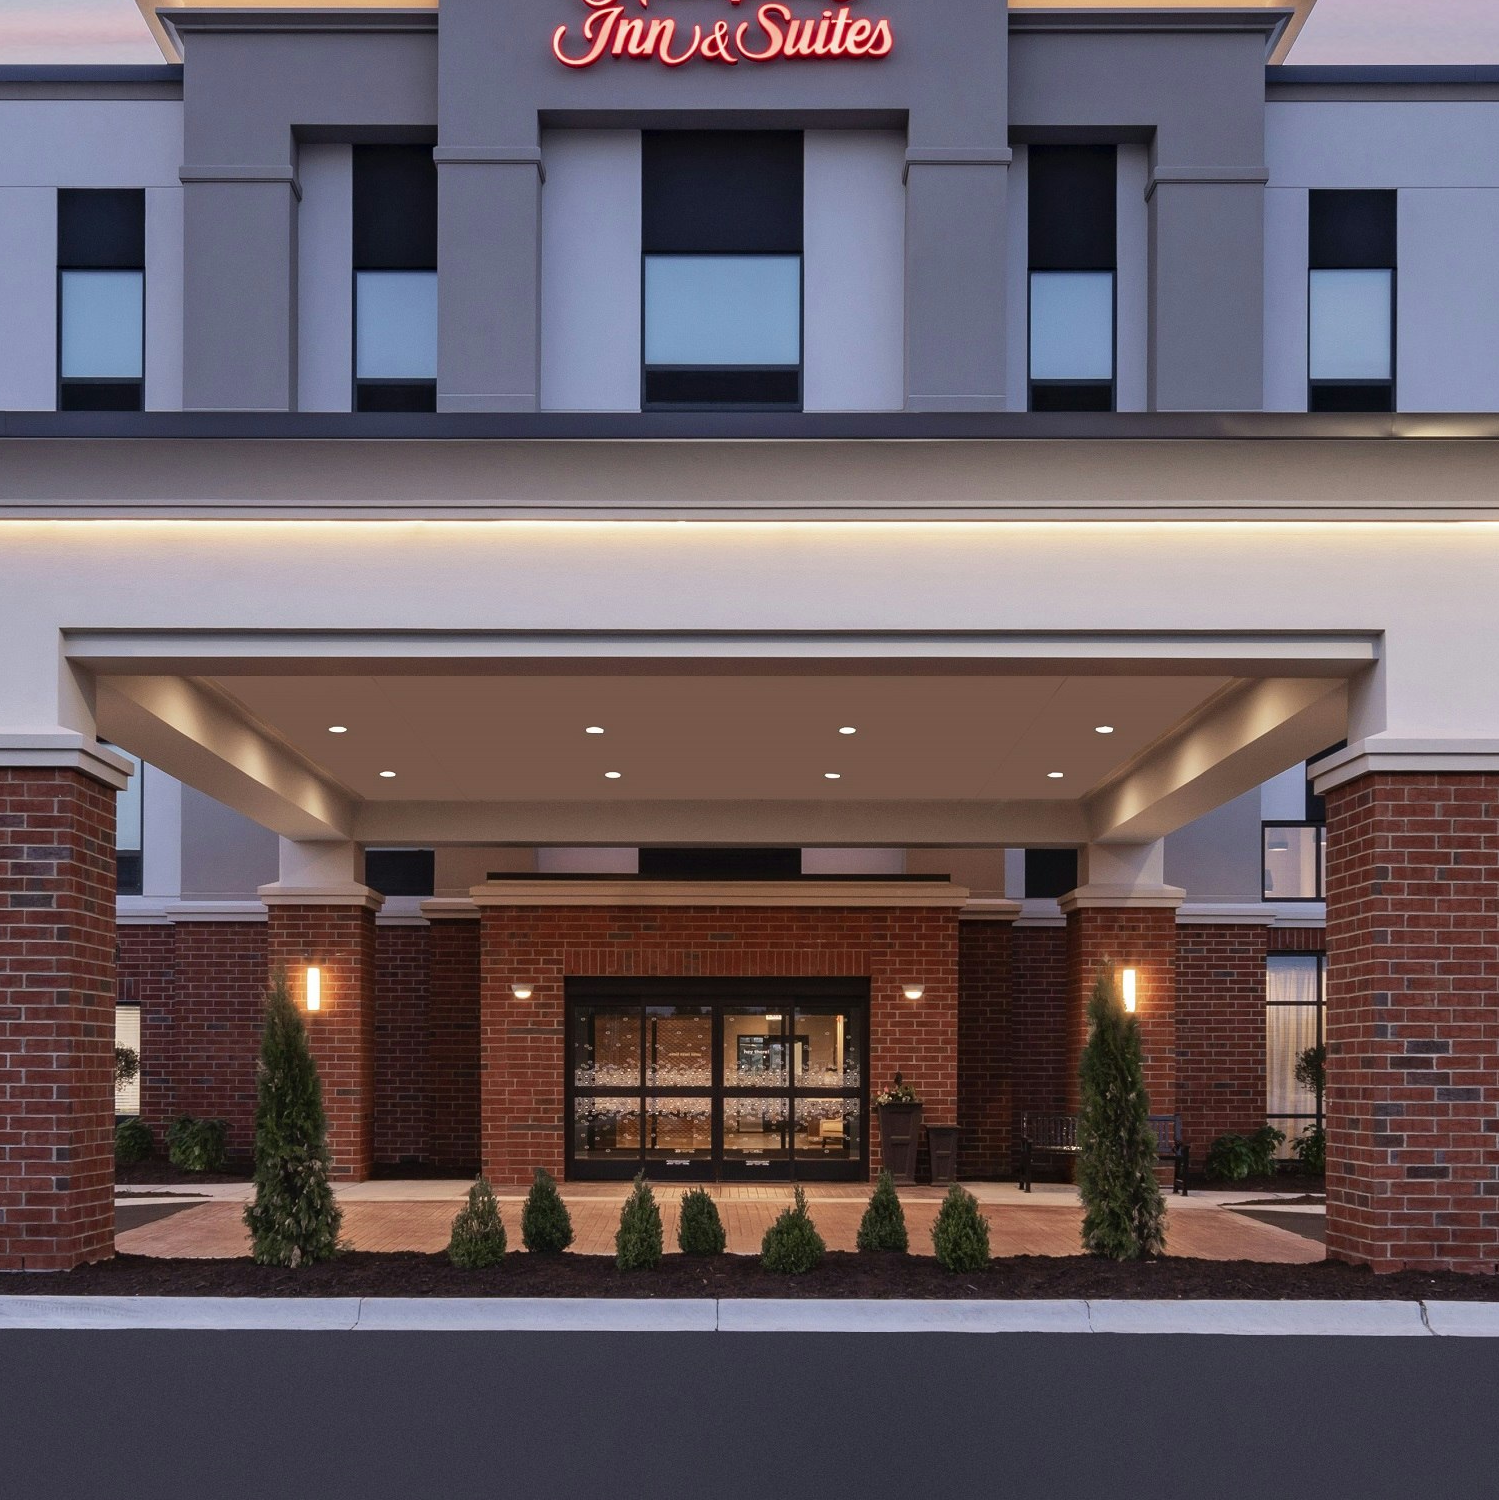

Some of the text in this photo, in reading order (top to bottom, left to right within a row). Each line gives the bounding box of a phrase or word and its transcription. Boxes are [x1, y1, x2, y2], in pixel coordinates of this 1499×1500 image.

[553, 2, 893, 68] Inn & Suites
